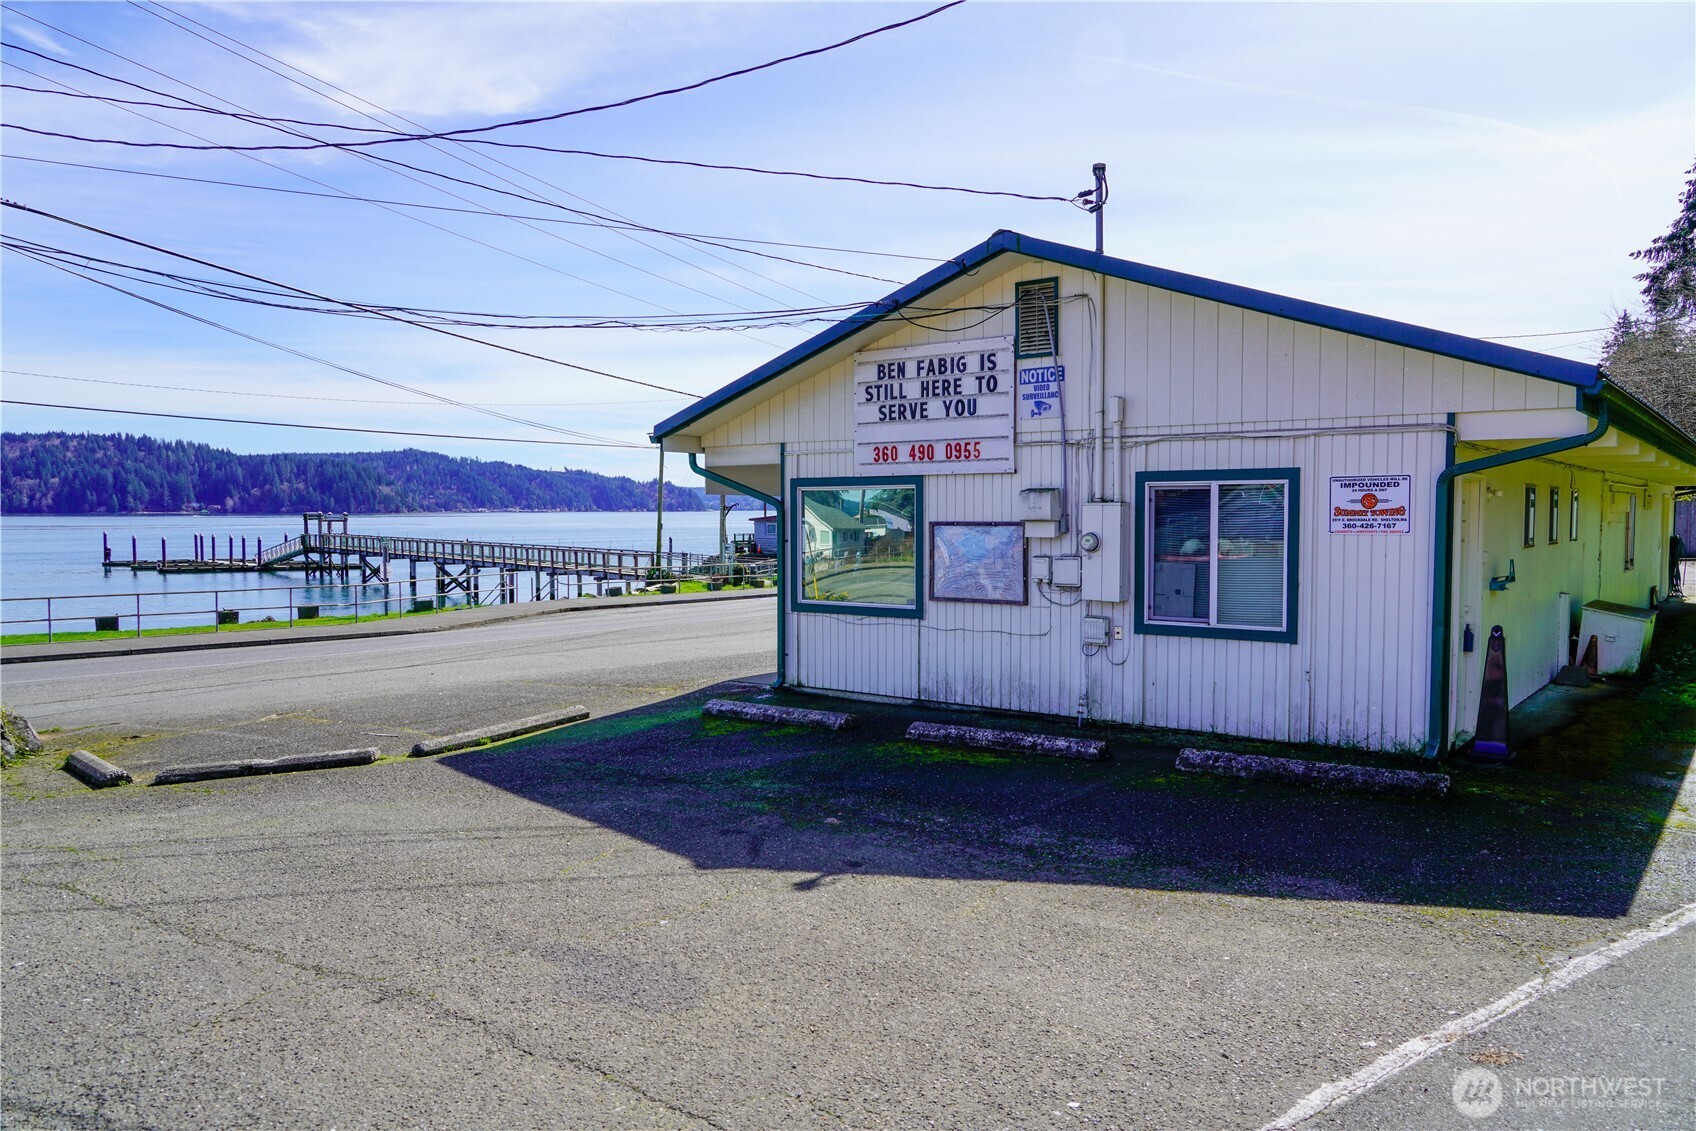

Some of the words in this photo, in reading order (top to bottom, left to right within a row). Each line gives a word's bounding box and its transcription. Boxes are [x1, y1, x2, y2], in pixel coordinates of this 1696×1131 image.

[877, 361, 906, 380] BEN
[916, 355, 967, 377] FABIG
[980, 353, 997, 371] IS
[1021, 367, 1063, 384] NOTICE
[865, 383, 907, 402] STILL
[921, 377, 963, 398] HERE
[975, 374, 998, 394] TO
[1022, 391, 1060, 401] SURVEILLANC
[1033, 384, 1050, 392] VIDEO
[878, 402, 928, 422] SERVE
[943, 398, 977, 417] YOU
[873, 445, 898, 463] 360
[909, 443, 935, 461] 490
[945, 441, 981, 460] 0955
[1370, 506, 1406, 516] TOWING
